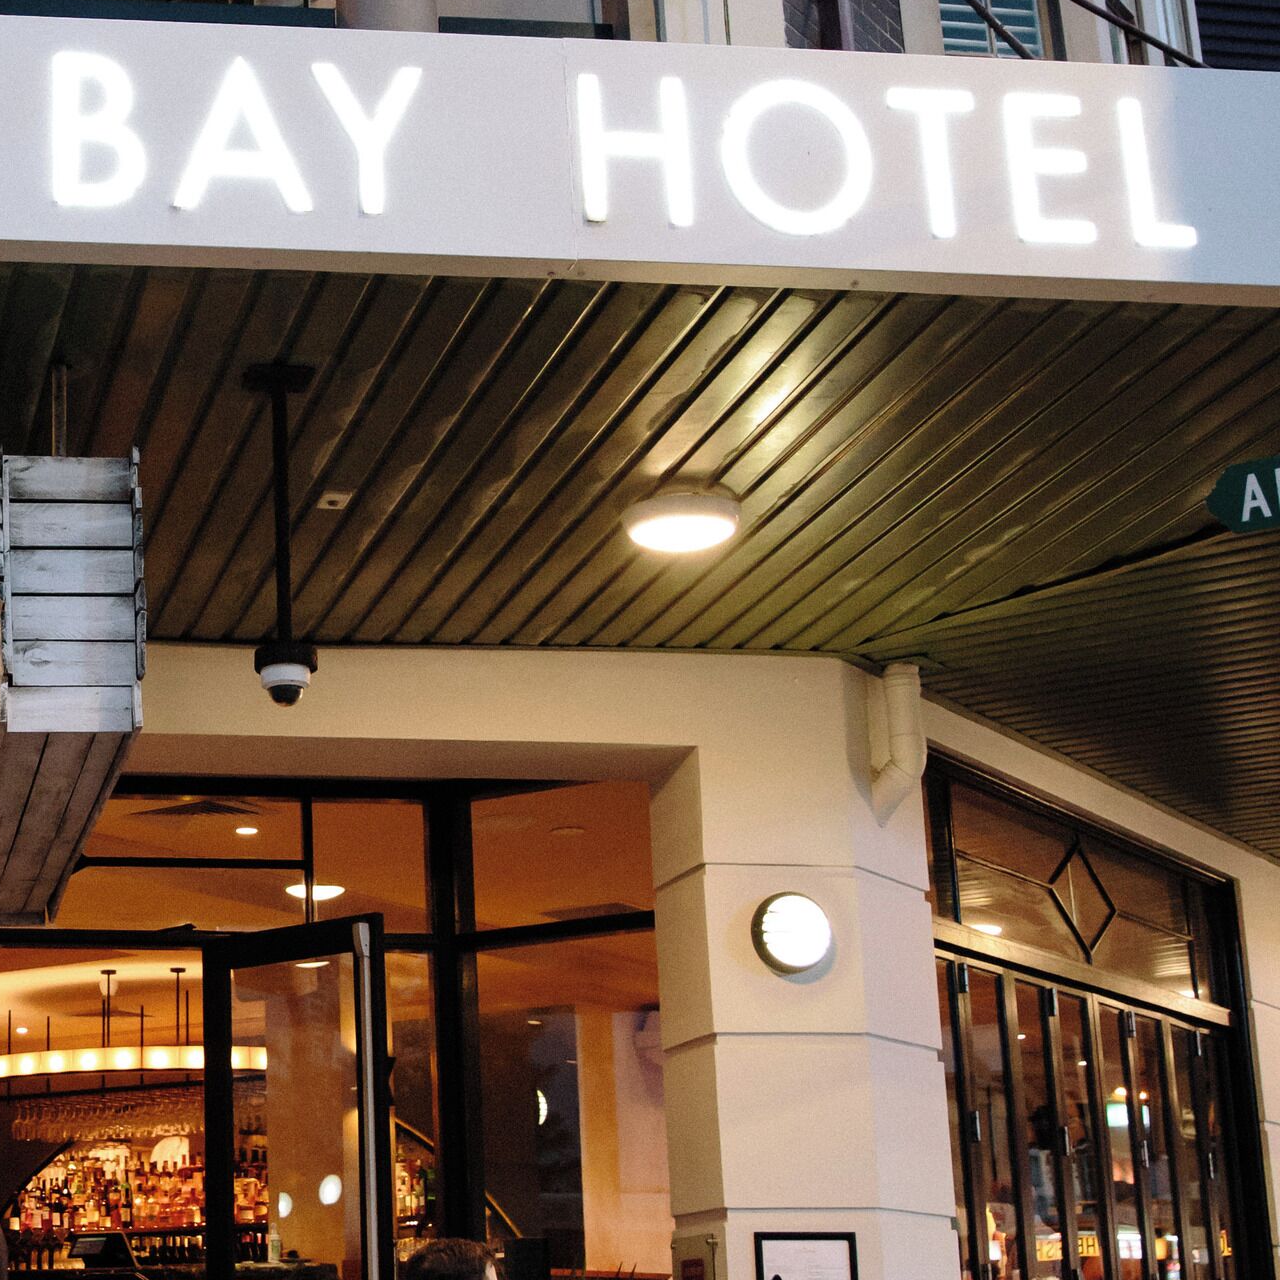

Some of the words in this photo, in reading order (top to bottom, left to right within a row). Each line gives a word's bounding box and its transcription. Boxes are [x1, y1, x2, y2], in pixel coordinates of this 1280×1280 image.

[48, 48, 423, 216] BAY
[575, 72, 1198, 250] HOTEL
[1241, 467, 1280, 522] A
